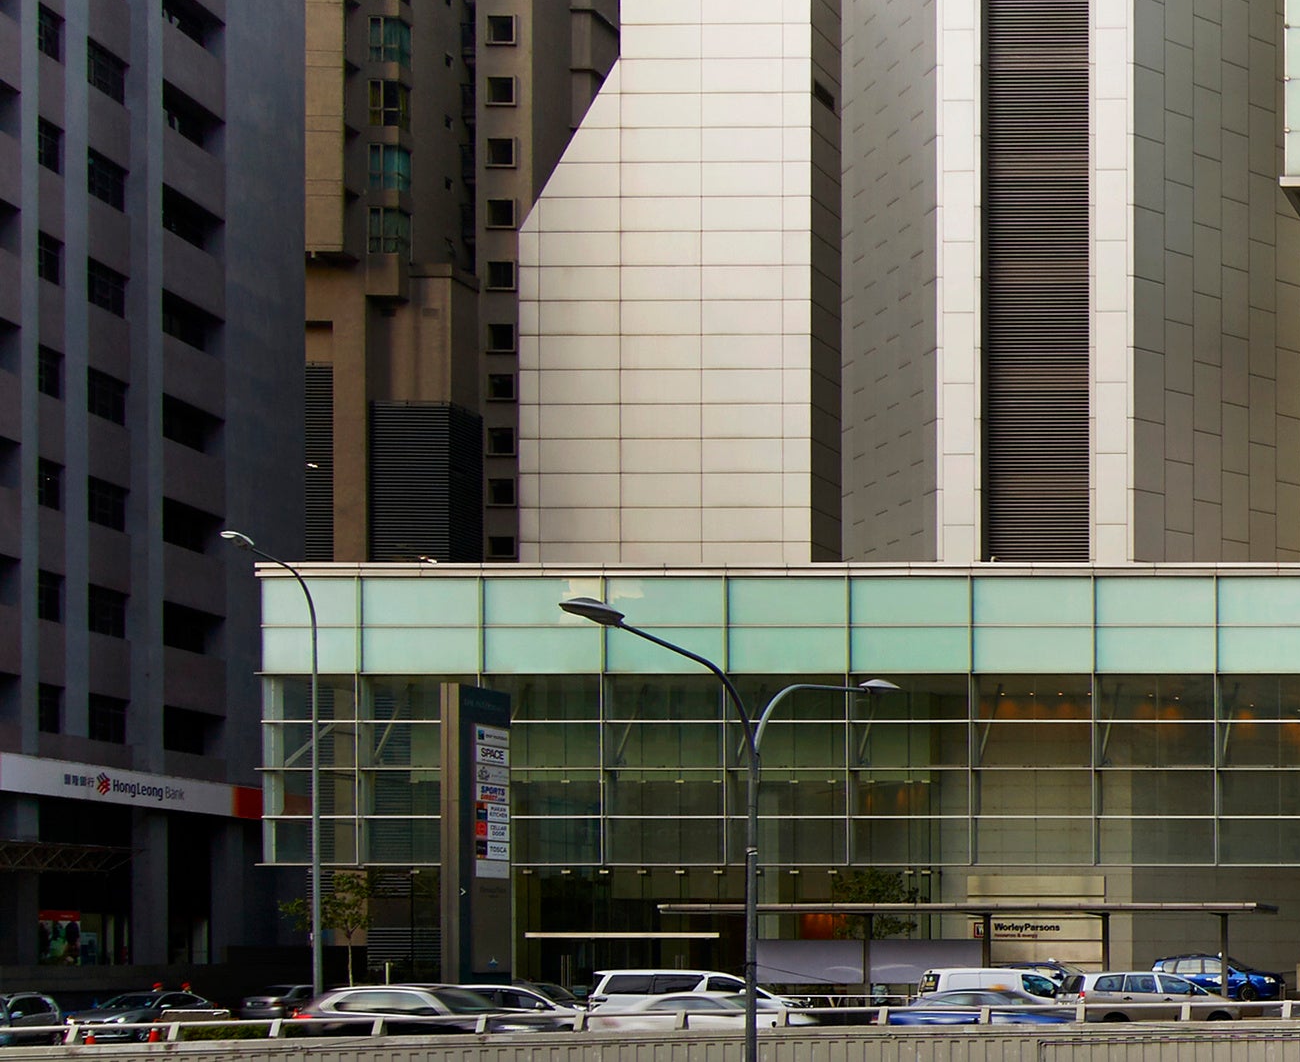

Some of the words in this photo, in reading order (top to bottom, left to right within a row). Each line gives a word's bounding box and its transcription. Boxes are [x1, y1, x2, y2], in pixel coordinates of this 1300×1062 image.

[481, 747, 504, 761] SPACE
[165, 786, 185, 800] Bank
[481, 785, 506, 797] SPORTS
[994, 923, 1060, 932] WorleyParsons
